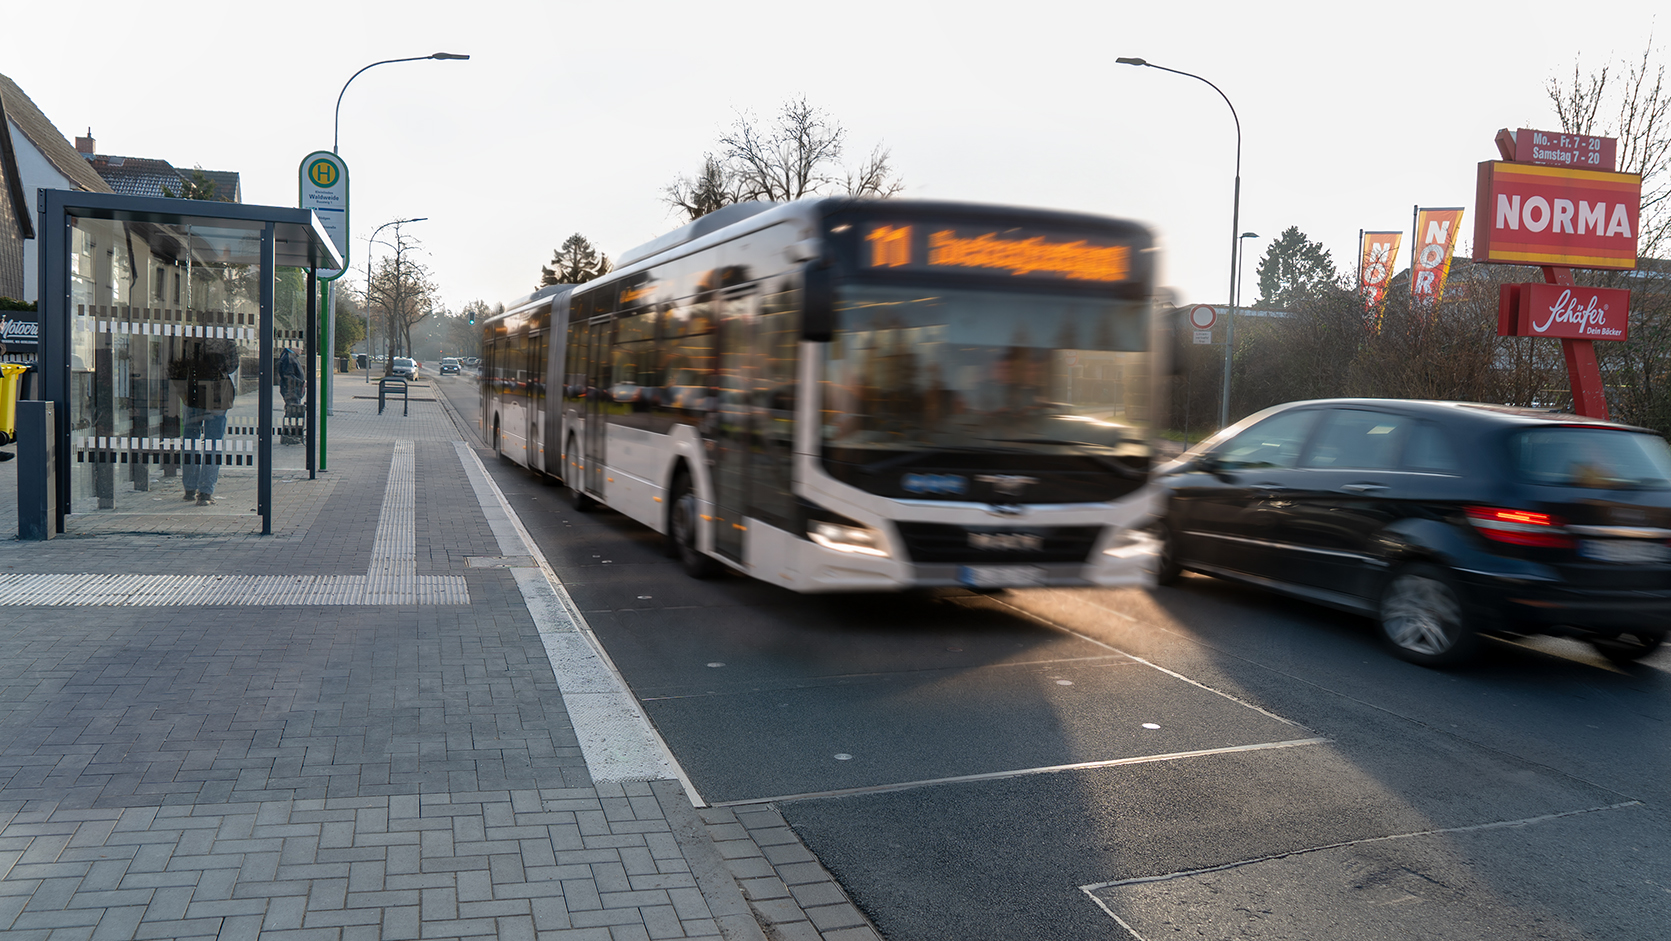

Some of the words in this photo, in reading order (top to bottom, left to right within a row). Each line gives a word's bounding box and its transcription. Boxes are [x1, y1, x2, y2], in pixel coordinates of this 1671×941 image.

[1533, 132, 1550, 146] Mo.
[1560, 135, 1572, 148] Fr.
[1574, 136, 1580, 149] 7
[1589, 138, 1601, 150] 20
[1532, 146, 1571, 164] Samstag
[1573, 150, 1579, 163] 7
[1588, 152, 1600, 165] 20
[317, 165, 330, 182] H
[1495, 193, 1632, 238] NORMA
[1532, 288, 1606, 334] Schäfer
[1587, 327, 1601, 335] Dein
[1602, 328, 1622, 336] Bäcker
